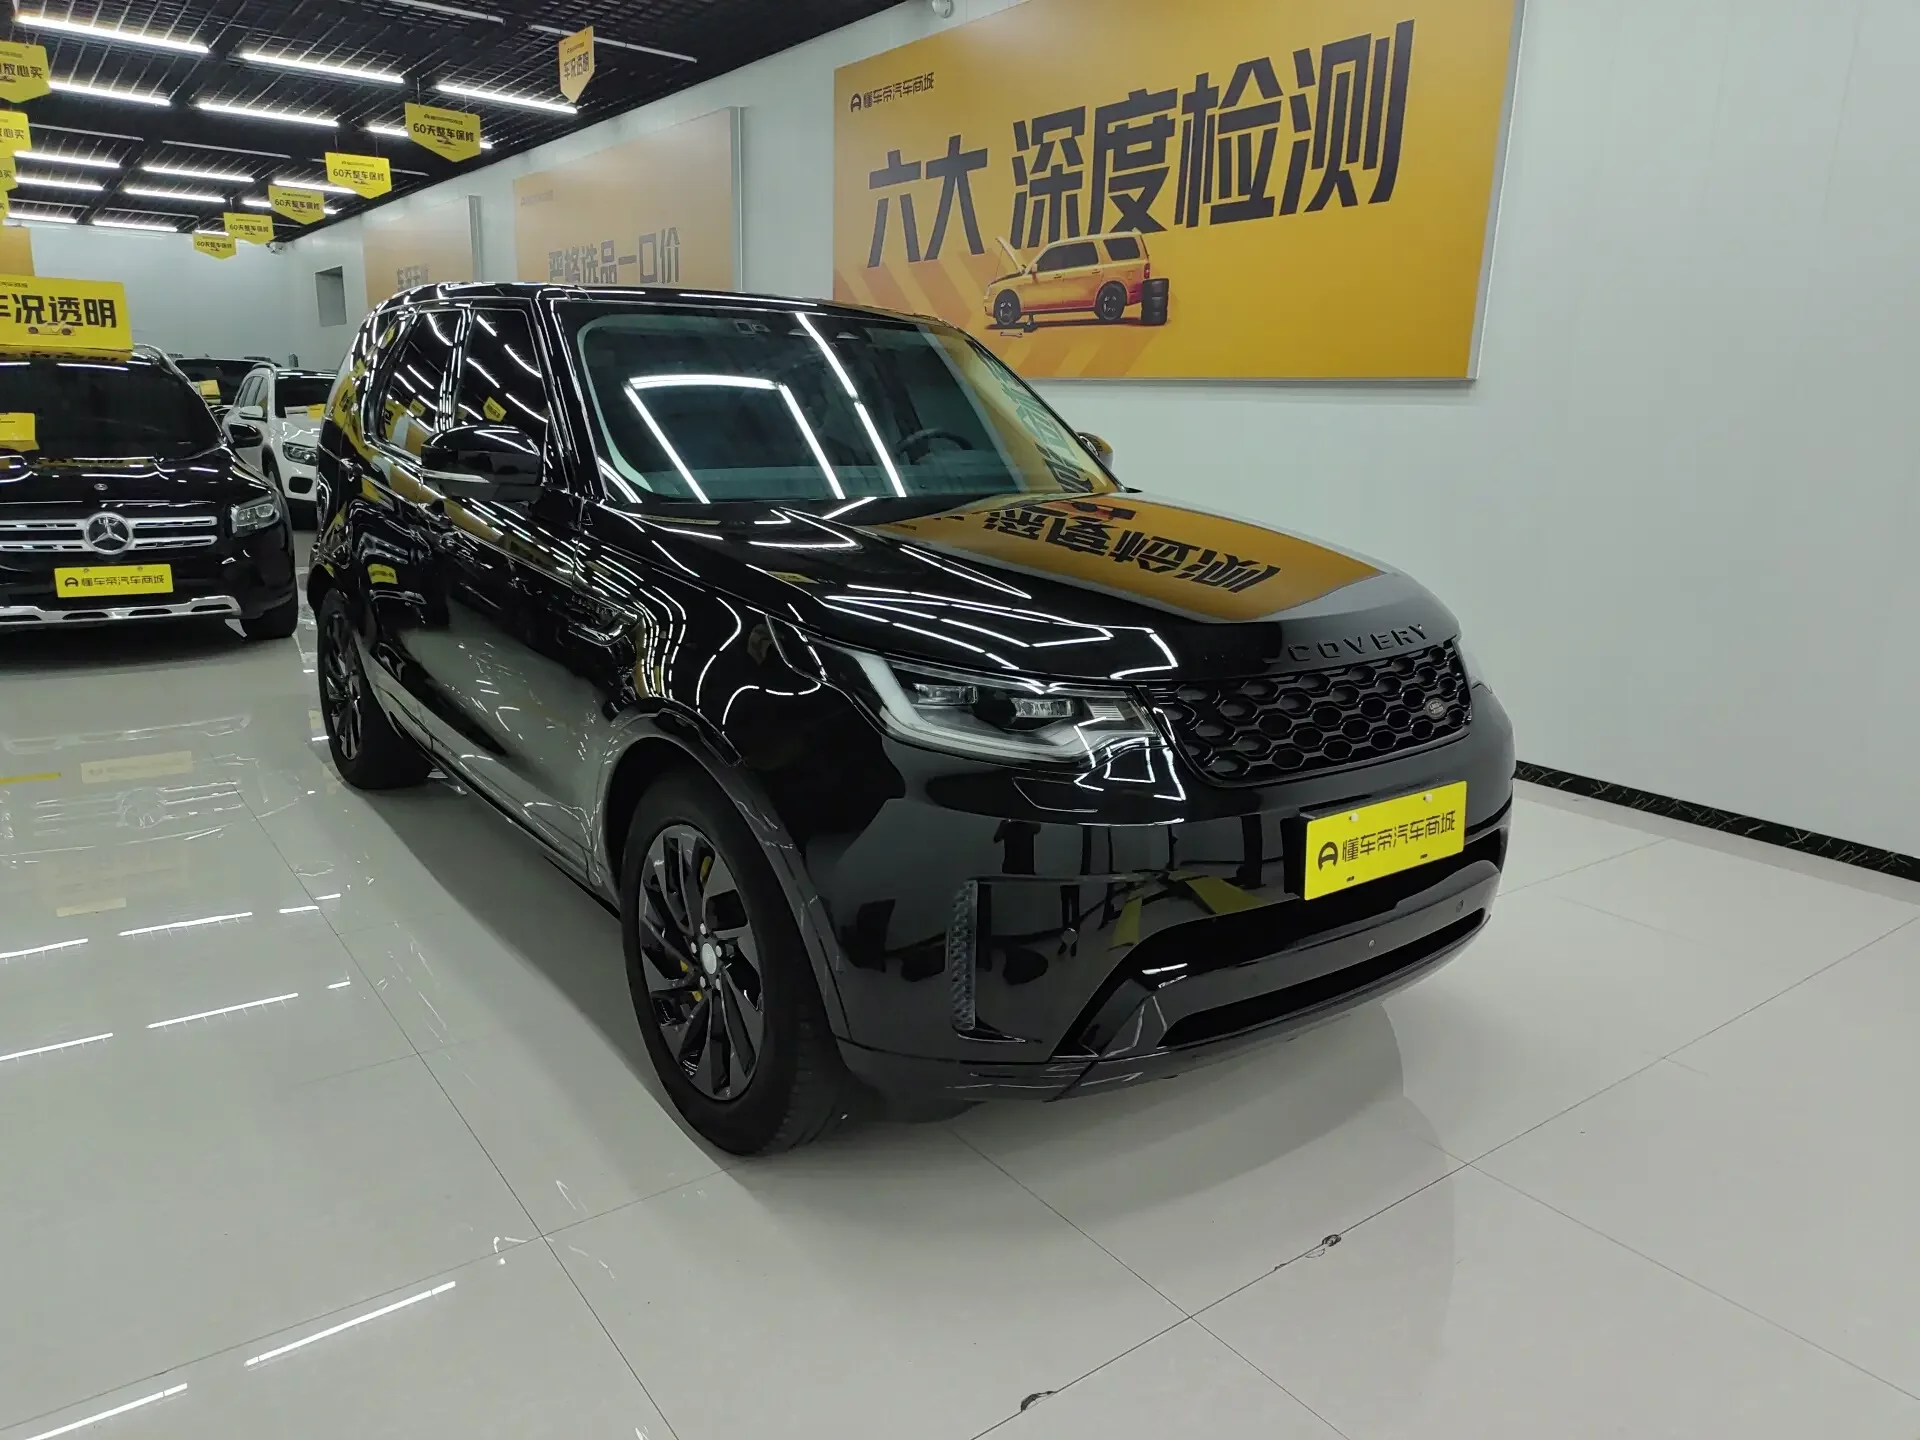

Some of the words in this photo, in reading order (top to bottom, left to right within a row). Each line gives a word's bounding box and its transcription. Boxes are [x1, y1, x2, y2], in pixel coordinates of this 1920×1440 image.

[0, 62, 44, 80] 放心买
[867, 133, 989, 268] 六大
[1010, 19, 1415, 250] 深度检测
[1341, 809, 1457, 863] 懂车帝汽车商城
